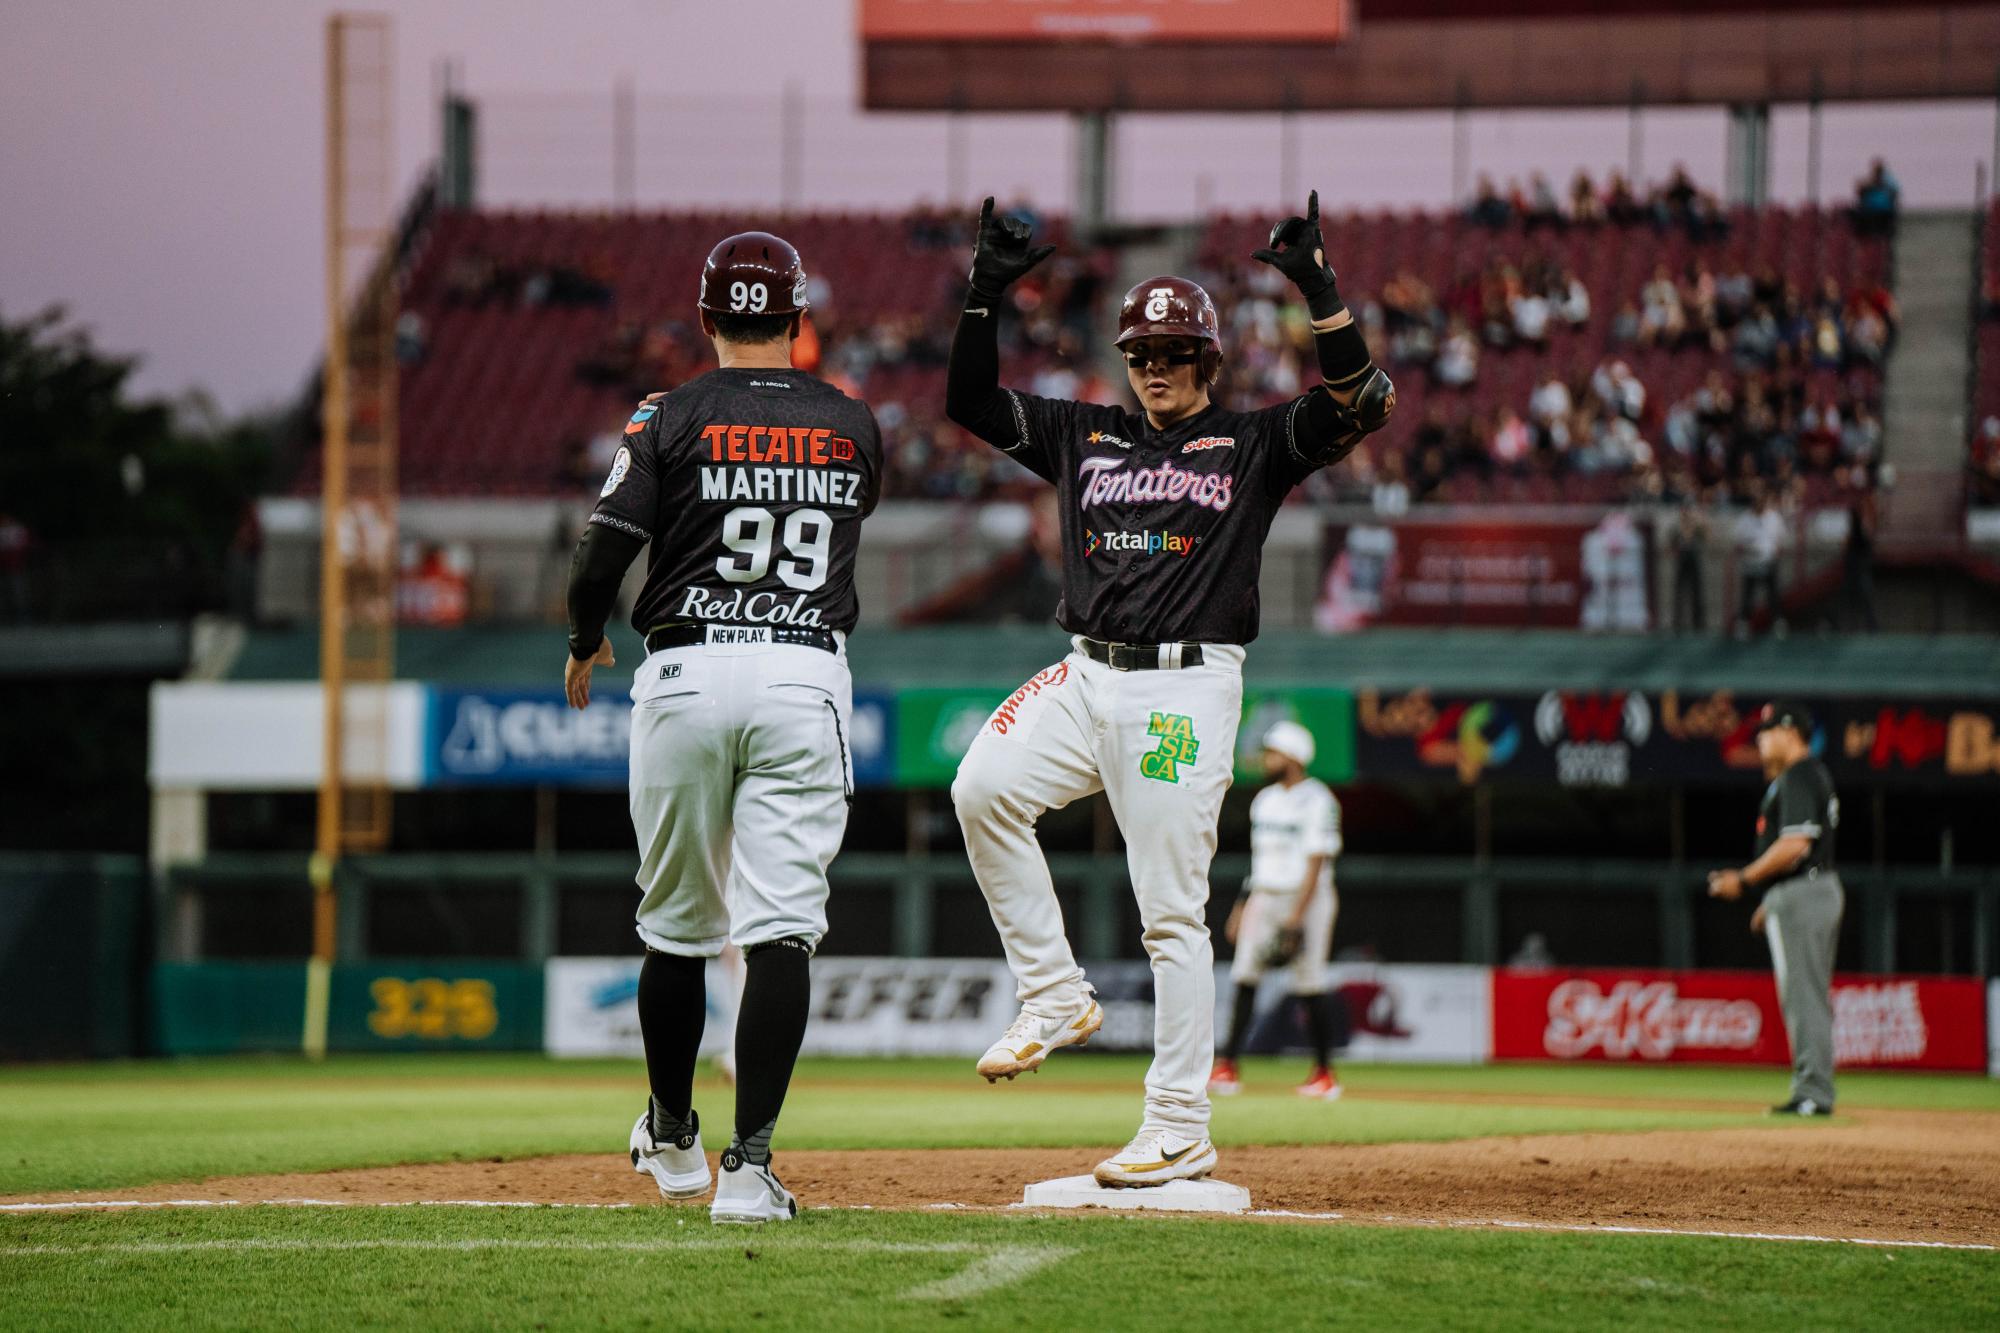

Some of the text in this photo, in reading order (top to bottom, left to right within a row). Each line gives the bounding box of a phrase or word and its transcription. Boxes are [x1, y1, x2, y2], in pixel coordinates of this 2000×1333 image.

[730, 281, 768, 313] 99
[700, 424, 832, 465] TECATE
[1183, 437, 1235, 453] SuKarne
[701, 466, 861, 508] MARTINEZ
[1078, 456, 1233, 512] Tomateros
[715, 506, 834, 593] 99
[712, 629, 734, 643] NEW
[661, 665, 681, 678] NP
